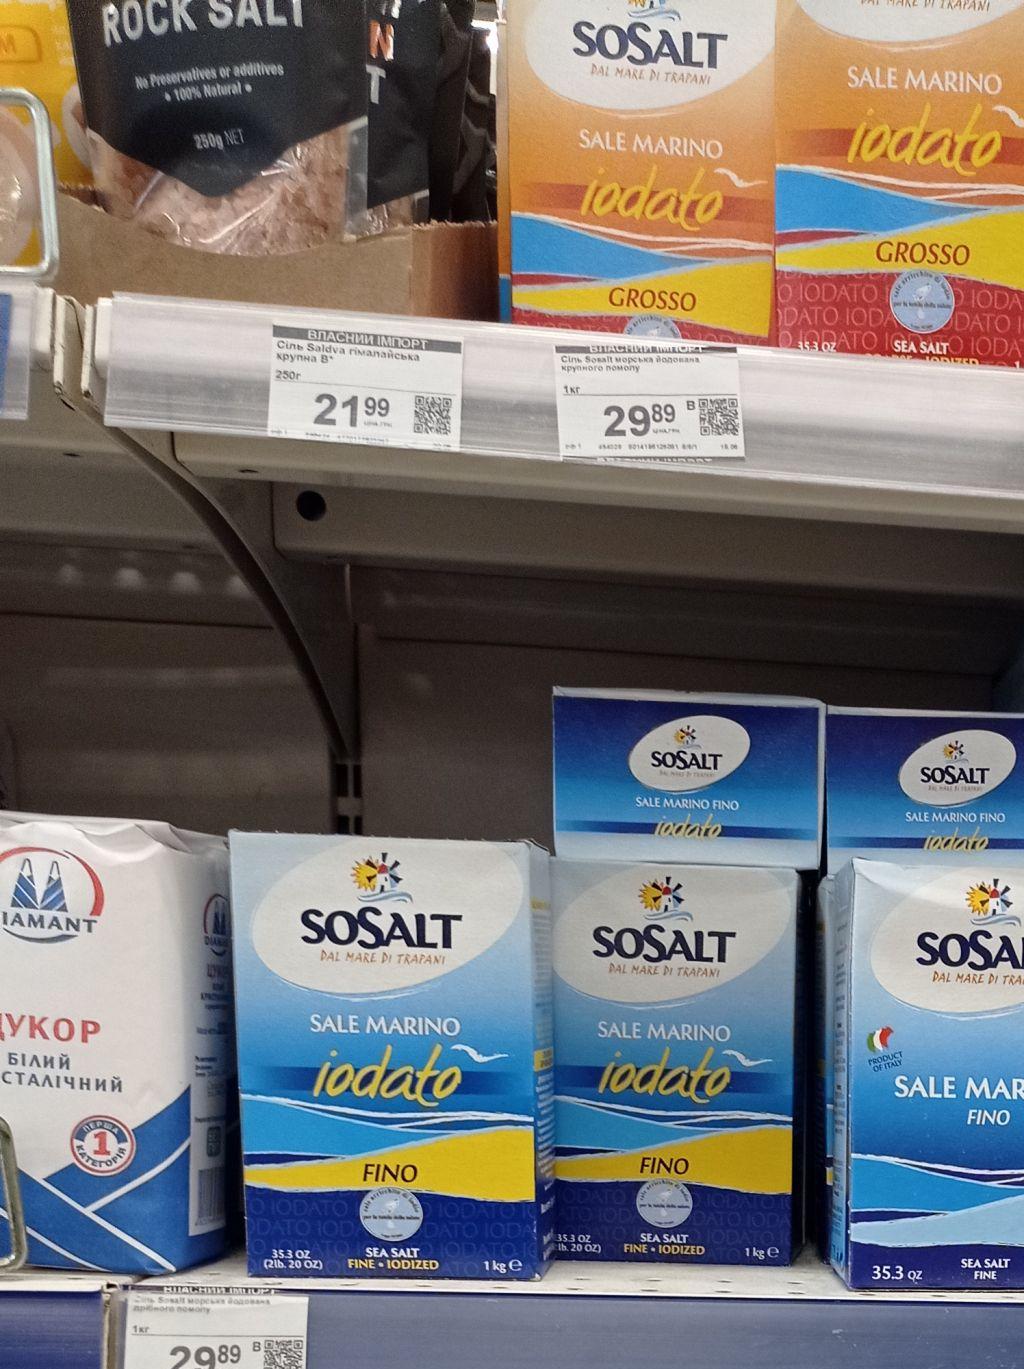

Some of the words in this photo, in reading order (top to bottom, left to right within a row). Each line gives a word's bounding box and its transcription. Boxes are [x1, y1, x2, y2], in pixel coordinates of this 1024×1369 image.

[101, 0, 198, 48] ROCK
[207, 0, 303, 29] SALT
[572, 20, 729, 69] SOSALT
[135, 75, 149, 90] No
[150, 66, 217, 87] Preservatives
[219, 65, 231, 78] or
[233, 60, 284, 78] additives
[591, 63, 609, 77] DAL
[615, 67, 645, 80] MARE
[650, 69, 660, 81] DI
[665, 71, 711, 85] TRAPANI
[848, 66, 897, 89] SALE
[904, 68, 1003, 95] MARINO
[173, 86, 202, 102] 100%
[203, 82, 242, 99] Natural
[193, 132, 224, 151] 250g
[224, 129, 245, 145] NET
[579, 129, 627, 151] SALE
[632, 133, 724, 160] MARINO
[847, 102, 1003, 177] iodato
[581, 163, 723, 232] iodato
[876, 241, 970, 266] GROSSO
[609, 287, 697, 312] GROSSO
[277, 340, 303, 351] Сіль
[350, 347, 420, 362] гімалайська
[377, 335, 429, 351] ІМПОРТ
[894, 340, 917, 354] SEA
[919, 341, 949, 355] SALT
[277, 353, 317, 365] крупна
[561, 364, 604, 374] крупного
[606, 365, 640, 374] помолу
[615, 357, 654, 366] морська
[656, 355, 700, 364] йодована
[275, 370, 301, 381] 250г
[313, 393, 359, 428] 21
[364, 396, 390, 418] 99
[603, 405, 651, 437] 29
[652, 404, 676, 423] 89
[651, 750, 723, 771] SOSALT
[920, 765, 990, 785] SOSALT
[635, 796, 661, 809] SALE
[663, 798, 710, 811] MARINO
[713, 799, 740, 811] FINO
[654, 813, 722, 842] iodato
[0, 910, 97, 935] IAMANT
[301, 906, 463, 950] SOSALT
[592, 924, 736, 963] SOSALT
[932, 970, 951, 983] DAL
[955, 972, 984, 984] MARE
[988, 973, 998, 985] DI
[310, 1013, 360, 1034] SALE
[366, 1015, 461, 1037] MARINO
[8, 1052, 71, 1071] БІЛИЙ
[868, 1050, 903, 1067] PRODUCT
[1, 1070, 123, 1093] СТАЛІЧНИЙ
[312, 1043, 463, 1108] iodato
[598, 1046, 731, 1104] iodato
[894, 1075, 957, 1100] SALE
[967, 1109, 1011, 1126] FINO
[93, 1131, 111, 1156] 1
[75, 1145, 127, 1168] КАТЕГОРІЯ
[362, 1163, 418, 1184] FINO
[365, 1247, 390, 1259] SEA
[391, 1247, 420, 1259] SALT
[347, 1259, 376, 1271] FINE
[387, 1259, 439, 1271] IODIZED
[217, 1344, 241, 1364] 89
